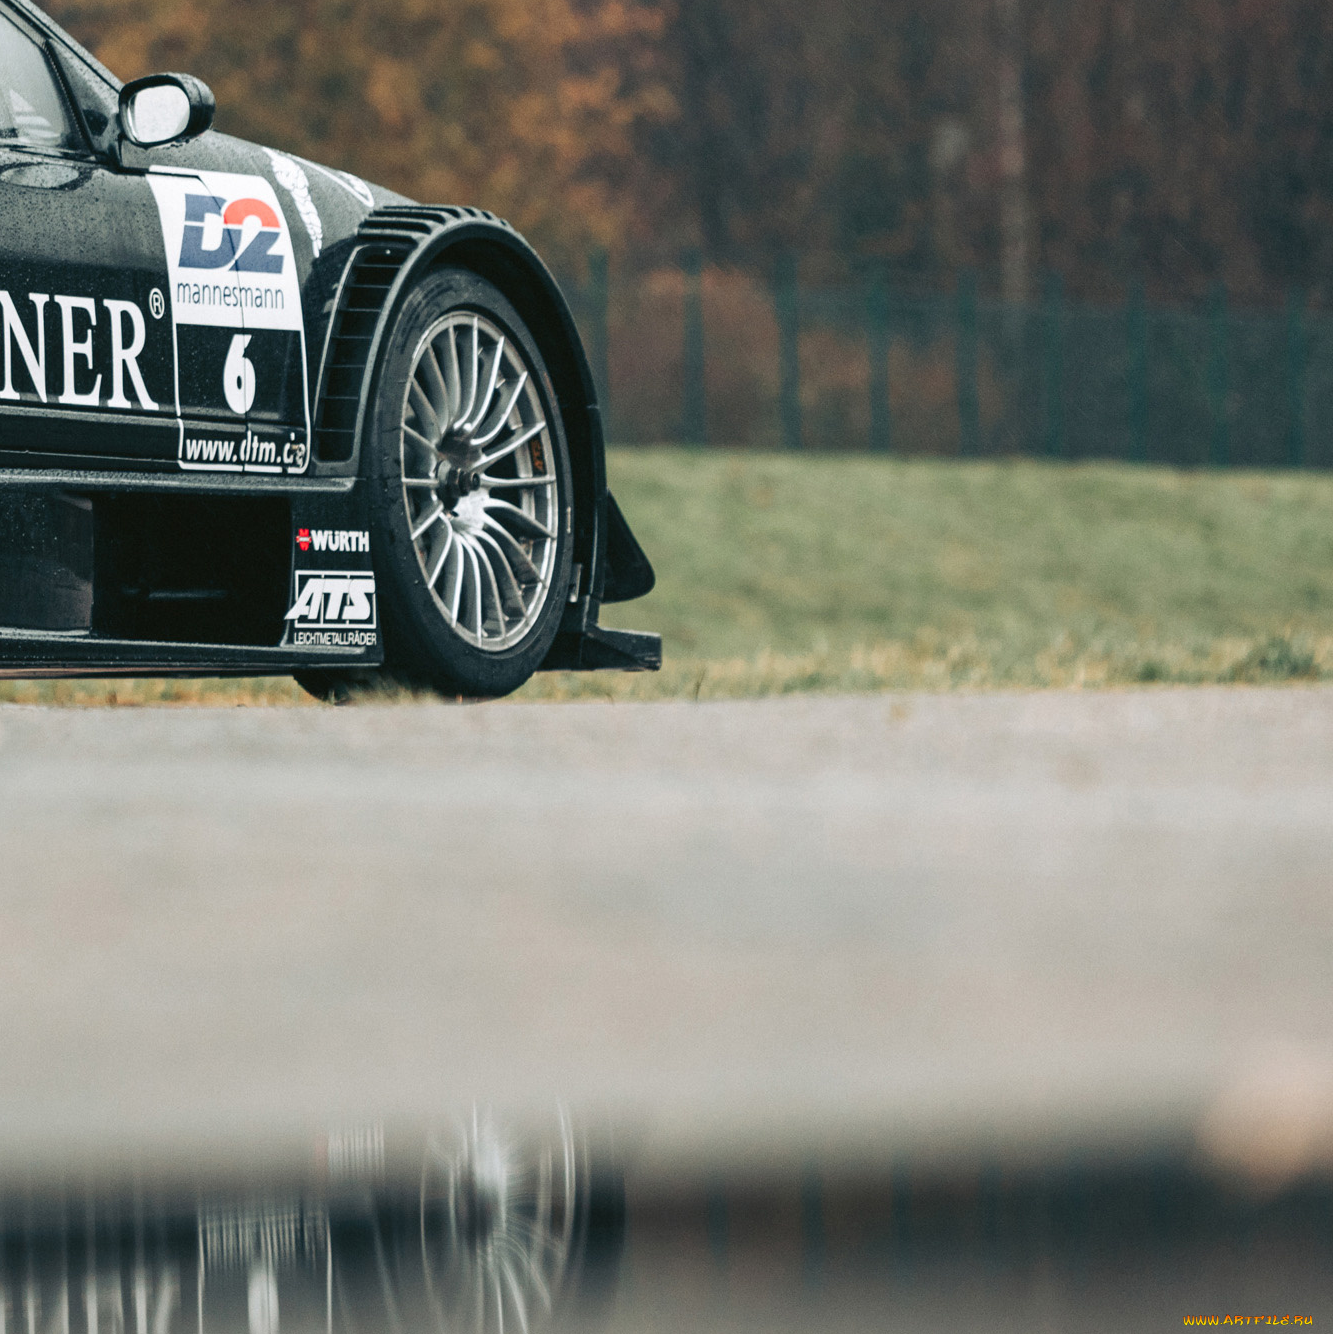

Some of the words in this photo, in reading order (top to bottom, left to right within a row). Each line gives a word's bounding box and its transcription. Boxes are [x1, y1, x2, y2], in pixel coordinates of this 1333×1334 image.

[178, 193, 285, 274] D2
[176, 280, 285, 309] mannesmann
[223, 333, 256, 414] 6
[310, 529, 370, 552] WÜRTH
[284, 577, 375, 620] ATS
[294, 630, 377, 646] LEICHTMETALLRÄDER
